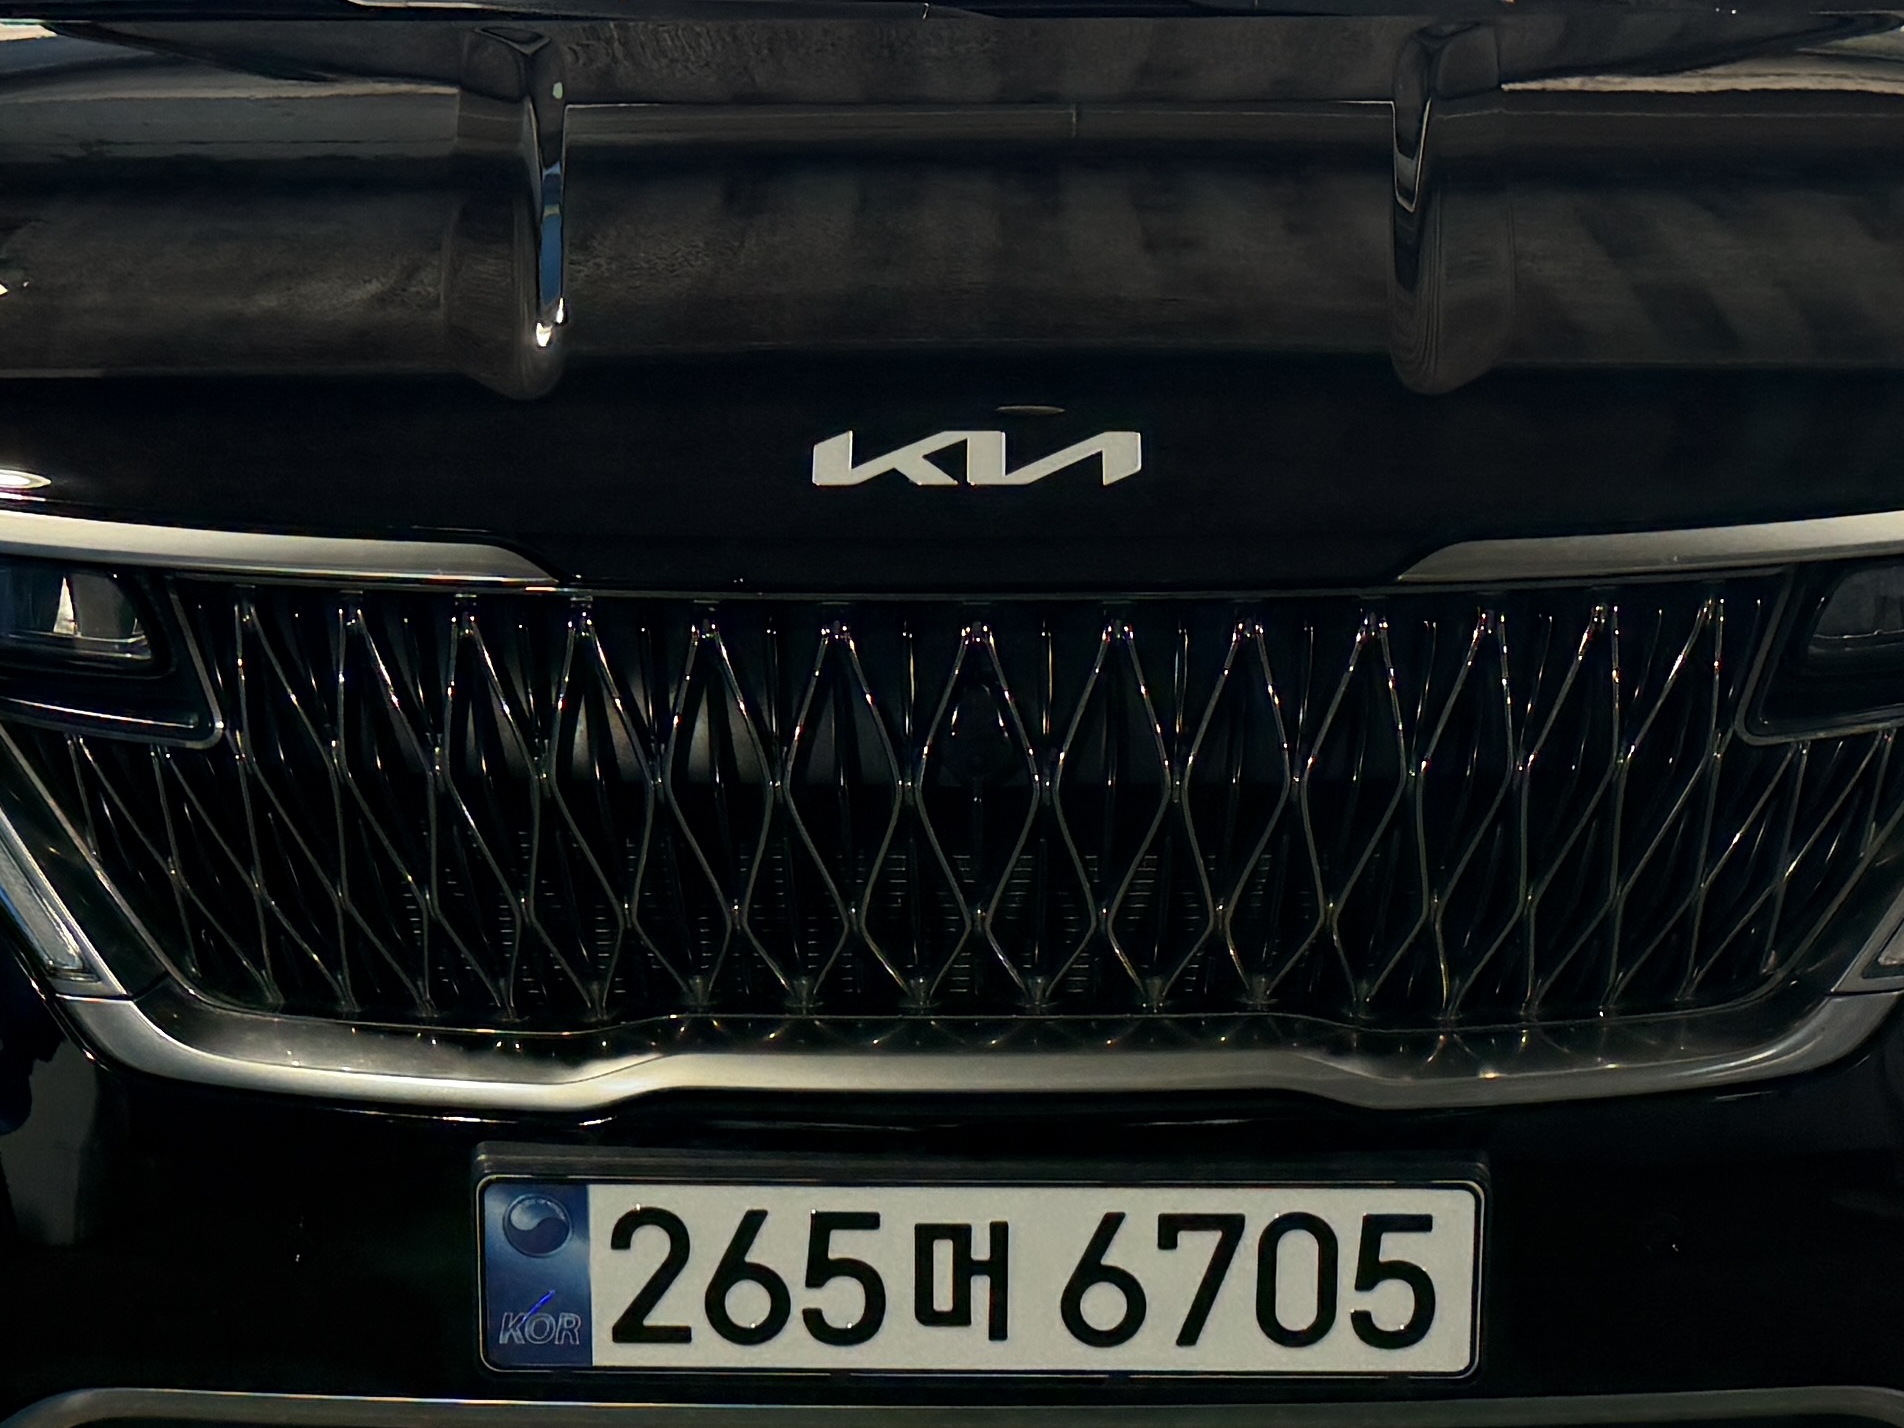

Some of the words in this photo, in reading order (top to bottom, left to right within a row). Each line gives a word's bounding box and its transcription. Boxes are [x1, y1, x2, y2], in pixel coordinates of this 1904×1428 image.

[811, 429, 1143, 487] KIA
[608, 1206, 1010, 1348] 265머
[1059, 1209, 1439, 1350] 6705
[498, 1311, 582, 1346] KOR
